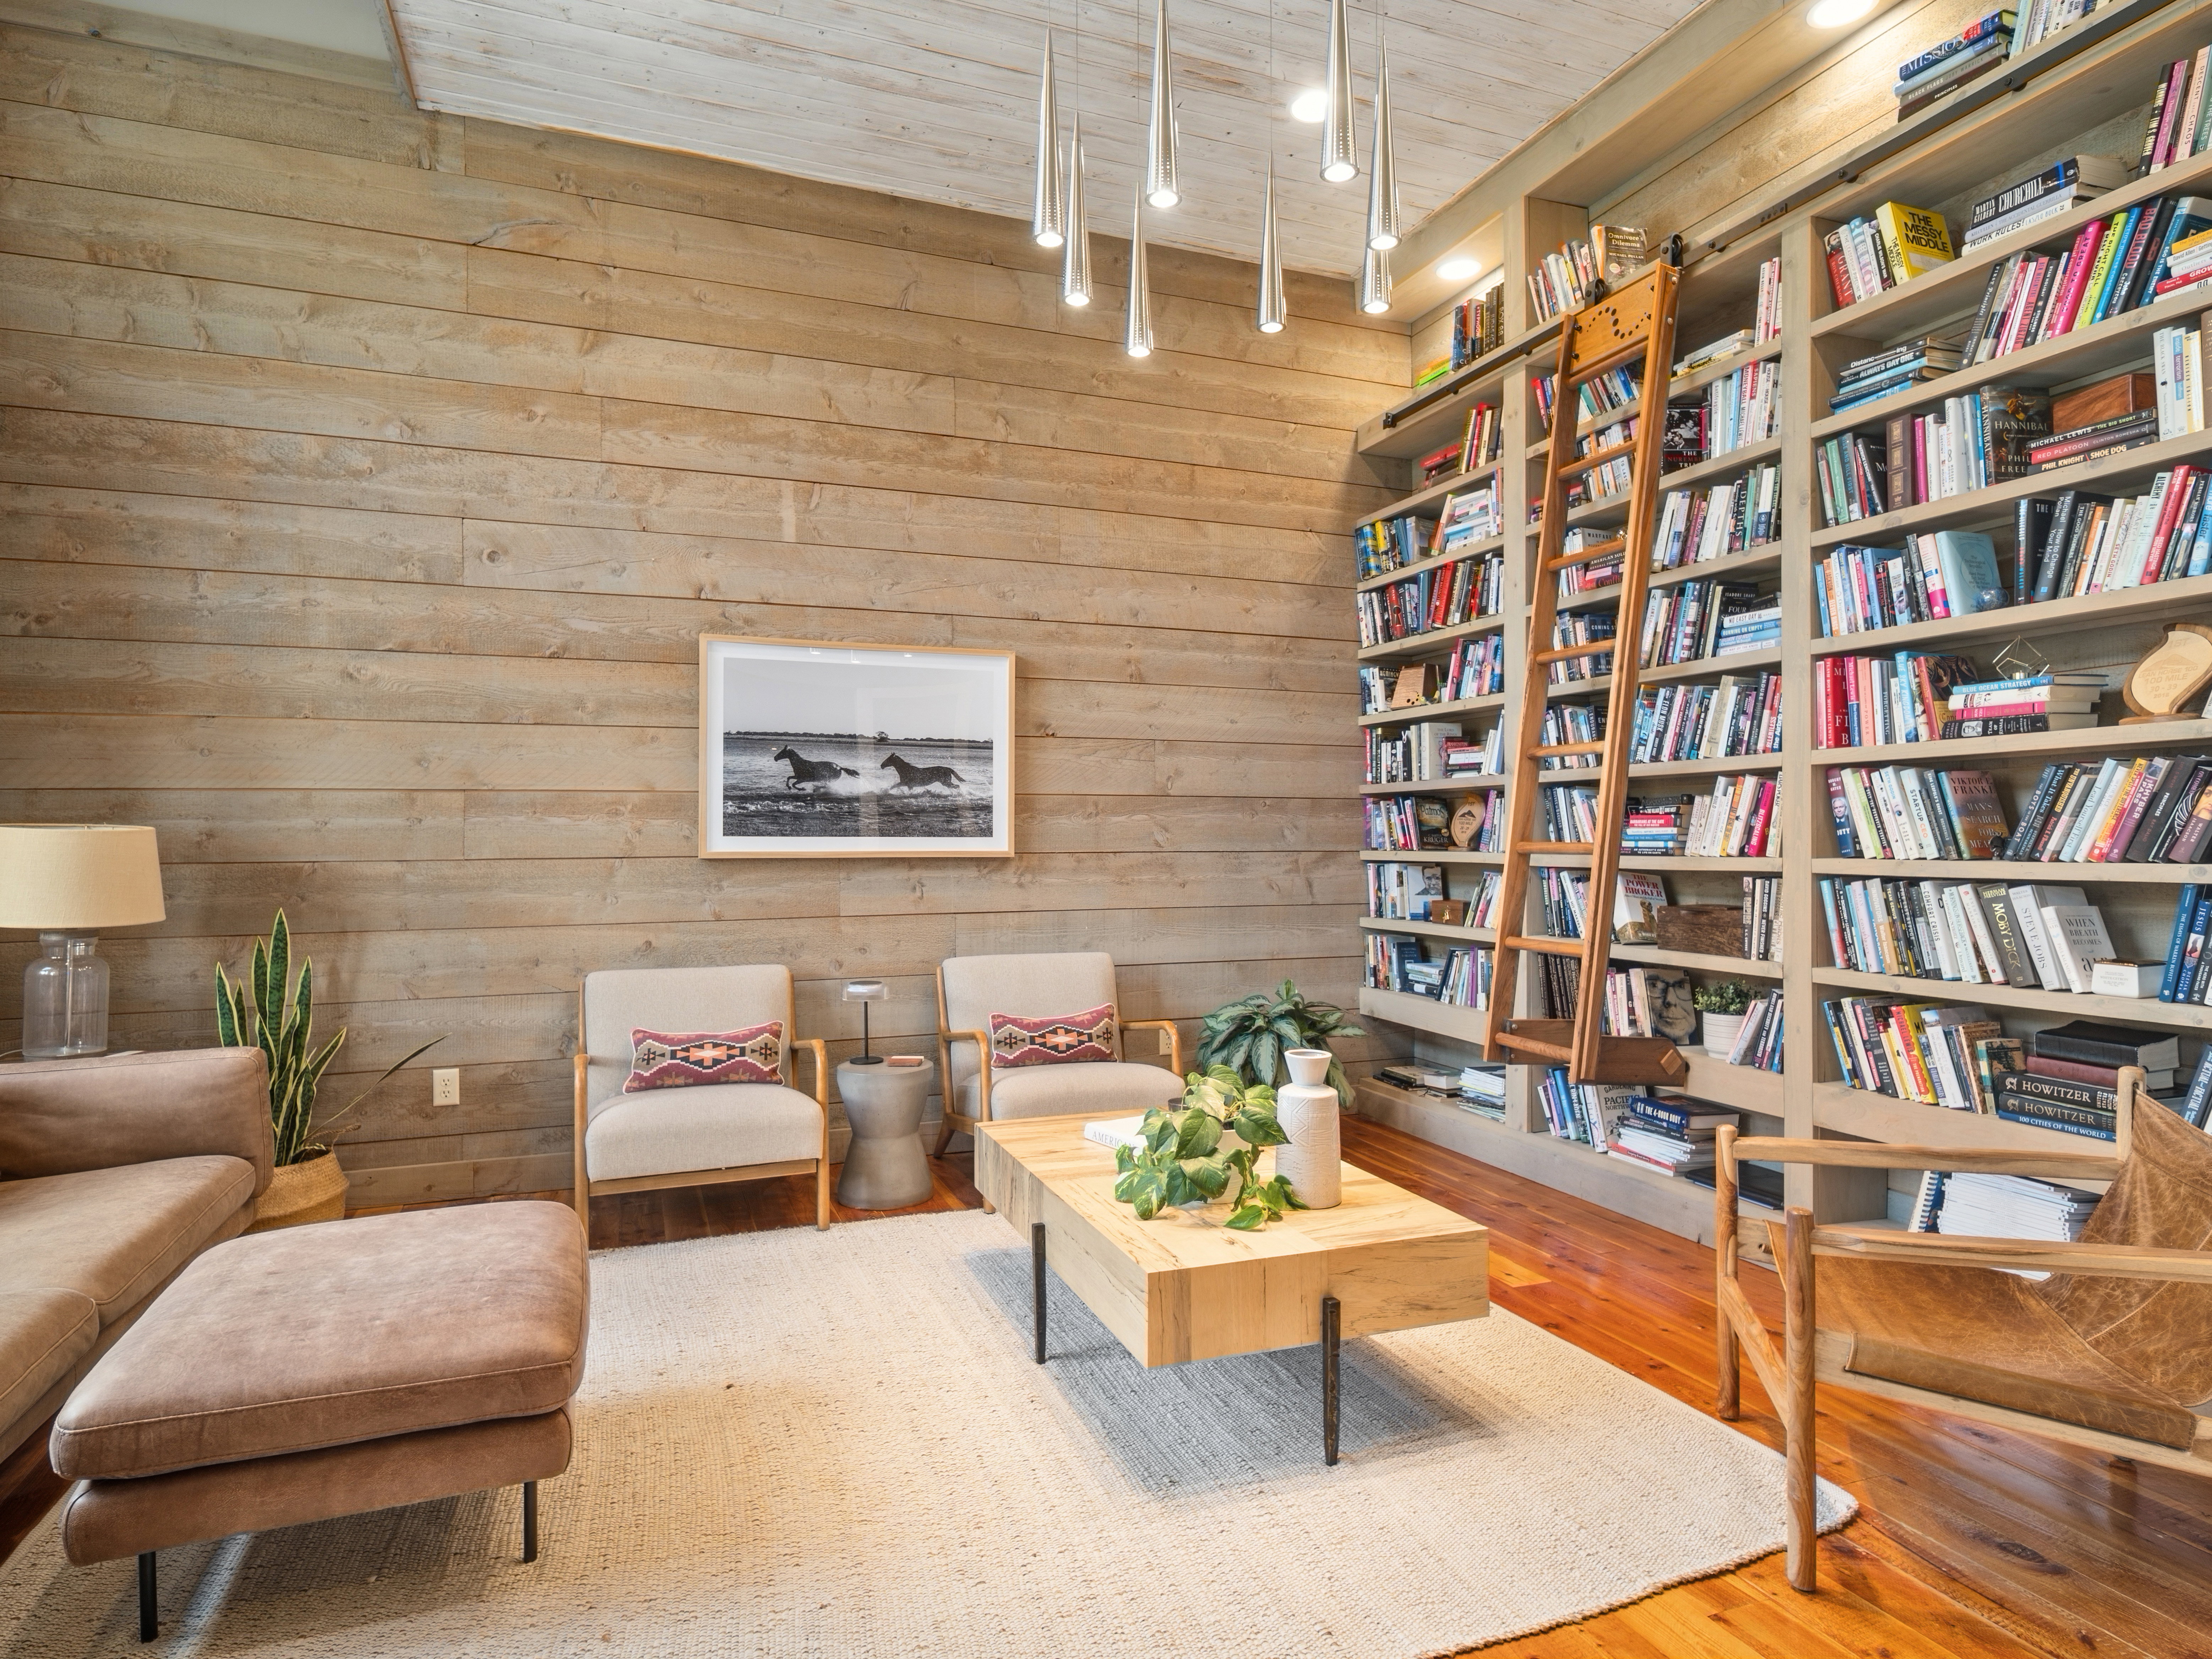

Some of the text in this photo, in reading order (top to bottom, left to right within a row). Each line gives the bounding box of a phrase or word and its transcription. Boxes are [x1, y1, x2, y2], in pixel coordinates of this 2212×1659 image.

[1908, 88, 1925, 100] BLACK
[1927, 77, 1944, 90] FLAGS
[1960, 57, 1984, 72] WARRICK
[2185, 66, 2205, 145] DESCENT CHAOS
[1999, 177, 2044, 212] CHURCHILL
[1974, 207, 1995, 223] GILBERT
[1976, 199, 1995, 214] MARTIN
[1908, 212, 1933, 228] THE
[1970, 233, 1993, 248] WORK
[1995, 219, 2025, 236] RULES!
[2045, 207, 2058, 217] BOCK
[2110, 222, 2119, 237] THE
[1608, 233, 1644, 241] Omnivore's
[1904, 222, 1942, 240] MESSY
[2125, 208, 2156, 269] BAD BLOOD
[1905, 233, 1949, 253] MIDDLE
[1838, 256, 1853, 297] GRANT
[2094, 267, 2104, 286] CALL
[2147, 278, 2156, 294] ENEMY
[1859, 352, 1914, 378] ALWAYS DAY ONE
[1995, 421, 2049, 431] HANNIBAL
[2119, 415, 2136, 424] SHORT
[1982, 406, 1990, 454] HANNIBAL
[2031, 428, 2092, 448] MICHAEL LEWIS
[2054, 442, 2088, 454] PLATOON
[2093, 436, 2114, 444] CLINTON
[2090, 445, 2127, 459] SHOE DOG
[2042, 455, 2085, 471] PHIL KNIGHT
[2155, 476, 2167, 500] ALCHEMY
[1736, 491, 1747, 537] DEPTHS
[2054, 497, 2064, 517] Pollan
[2060, 496, 2071, 523] Michael
[1591, 554, 1613, 565] AMERICAN
[2043, 546, 2053, 562] Mind
[2047, 551, 2059, 579] Change
[1723, 627, 1741, 636] RUNNING
[1759, 675, 1767, 700] ENDURE
[1962, 680, 2032, 693] BLUE OCEAN STRATEGY
[1657, 701, 1669, 732] ELON MUSK
[1589, 713, 1597, 741] ENDURANC
[1766, 716, 1776, 748] RELENTLESS
[2132, 779, 2154, 819] KHYBER
[2134, 781, 2147, 804] PASS
[1421, 805, 1445, 818] Patmos
[1910, 789, 1928, 838] STARTUP CEO
[1967, 803, 1992, 811] MAN'S
[1751, 809, 1765, 846] BLITZSCALING
[1625, 879, 1660, 889] POWER
[1625, 886, 1663, 898] BROKER
[1573, 910, 1581, 929] MAKERS
[2065, 918, 2094, 927] WHEN
[2195, 907, 2206, 931] JESUS
[1992, 903, 2021, 969] MOBY DICK
[2021, 907, 2047, 968] STEVE JOBS
[2022, 1081, 2091, 1103] HOWITZER
[1645, 1105, 1681, 1124] THE 4-HOUR BODY
[2025, 1103, 2096, 1125] HOWITZER
[2031, 1118, 2052, 1128] CITIES
[2064, 1124, 2078, 1134] THE
[2079, 1127, 2106, 1139] WORLD
